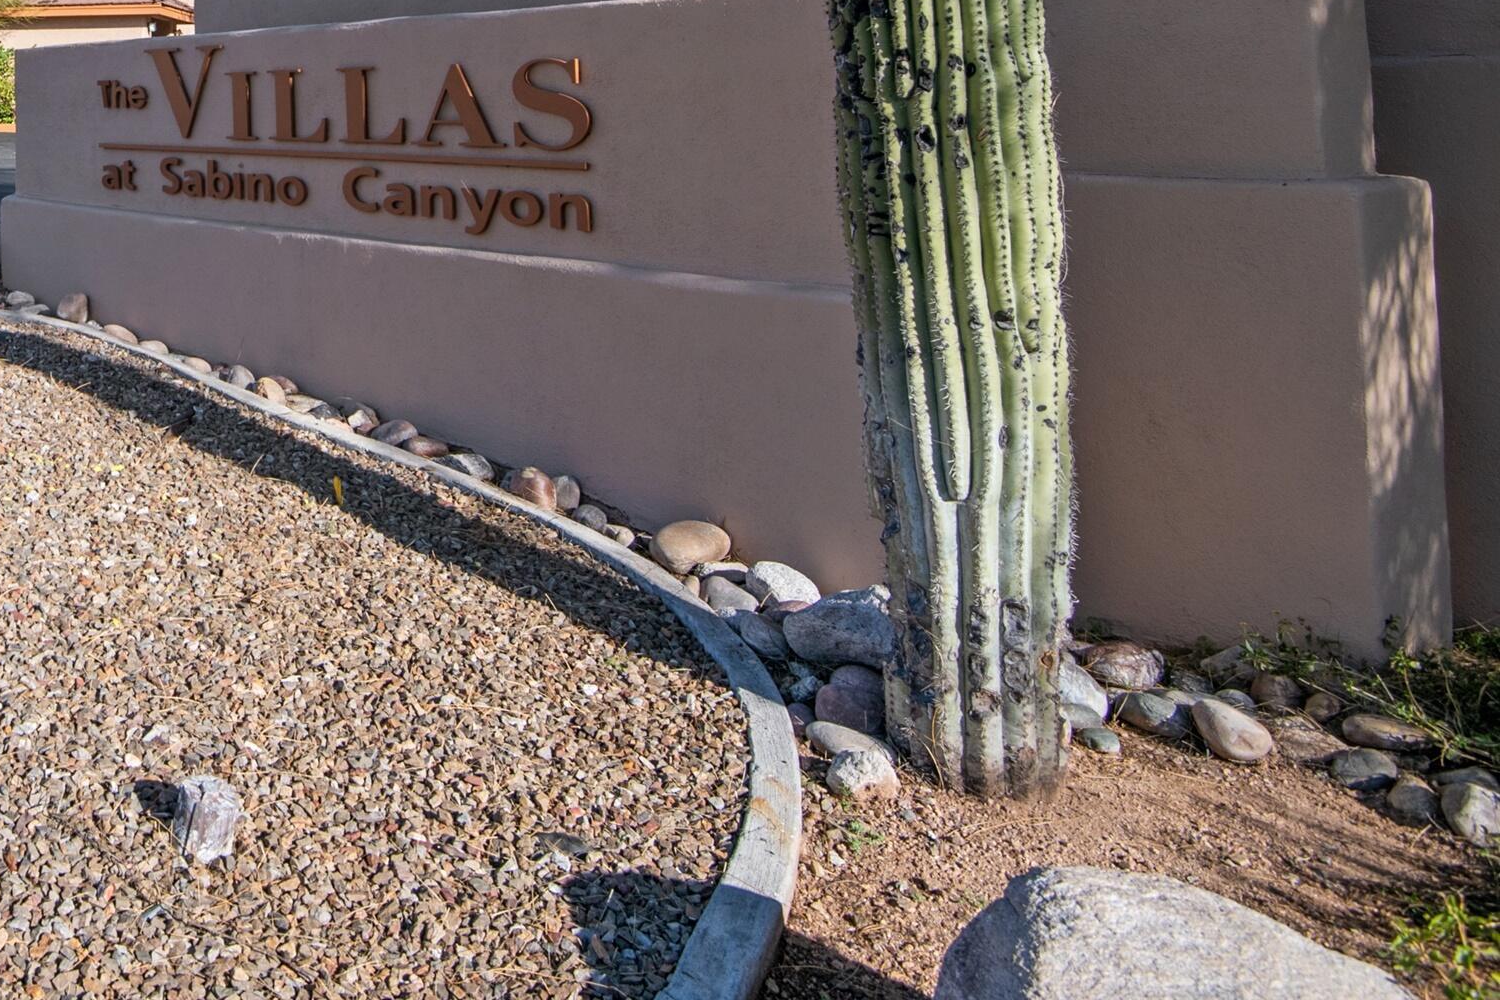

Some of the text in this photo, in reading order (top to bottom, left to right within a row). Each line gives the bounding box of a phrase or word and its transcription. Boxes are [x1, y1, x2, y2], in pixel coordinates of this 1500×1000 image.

[98, 44, 593, 152] The VILLAS
[101, 157, 593, 235] at Sabino Canyon
